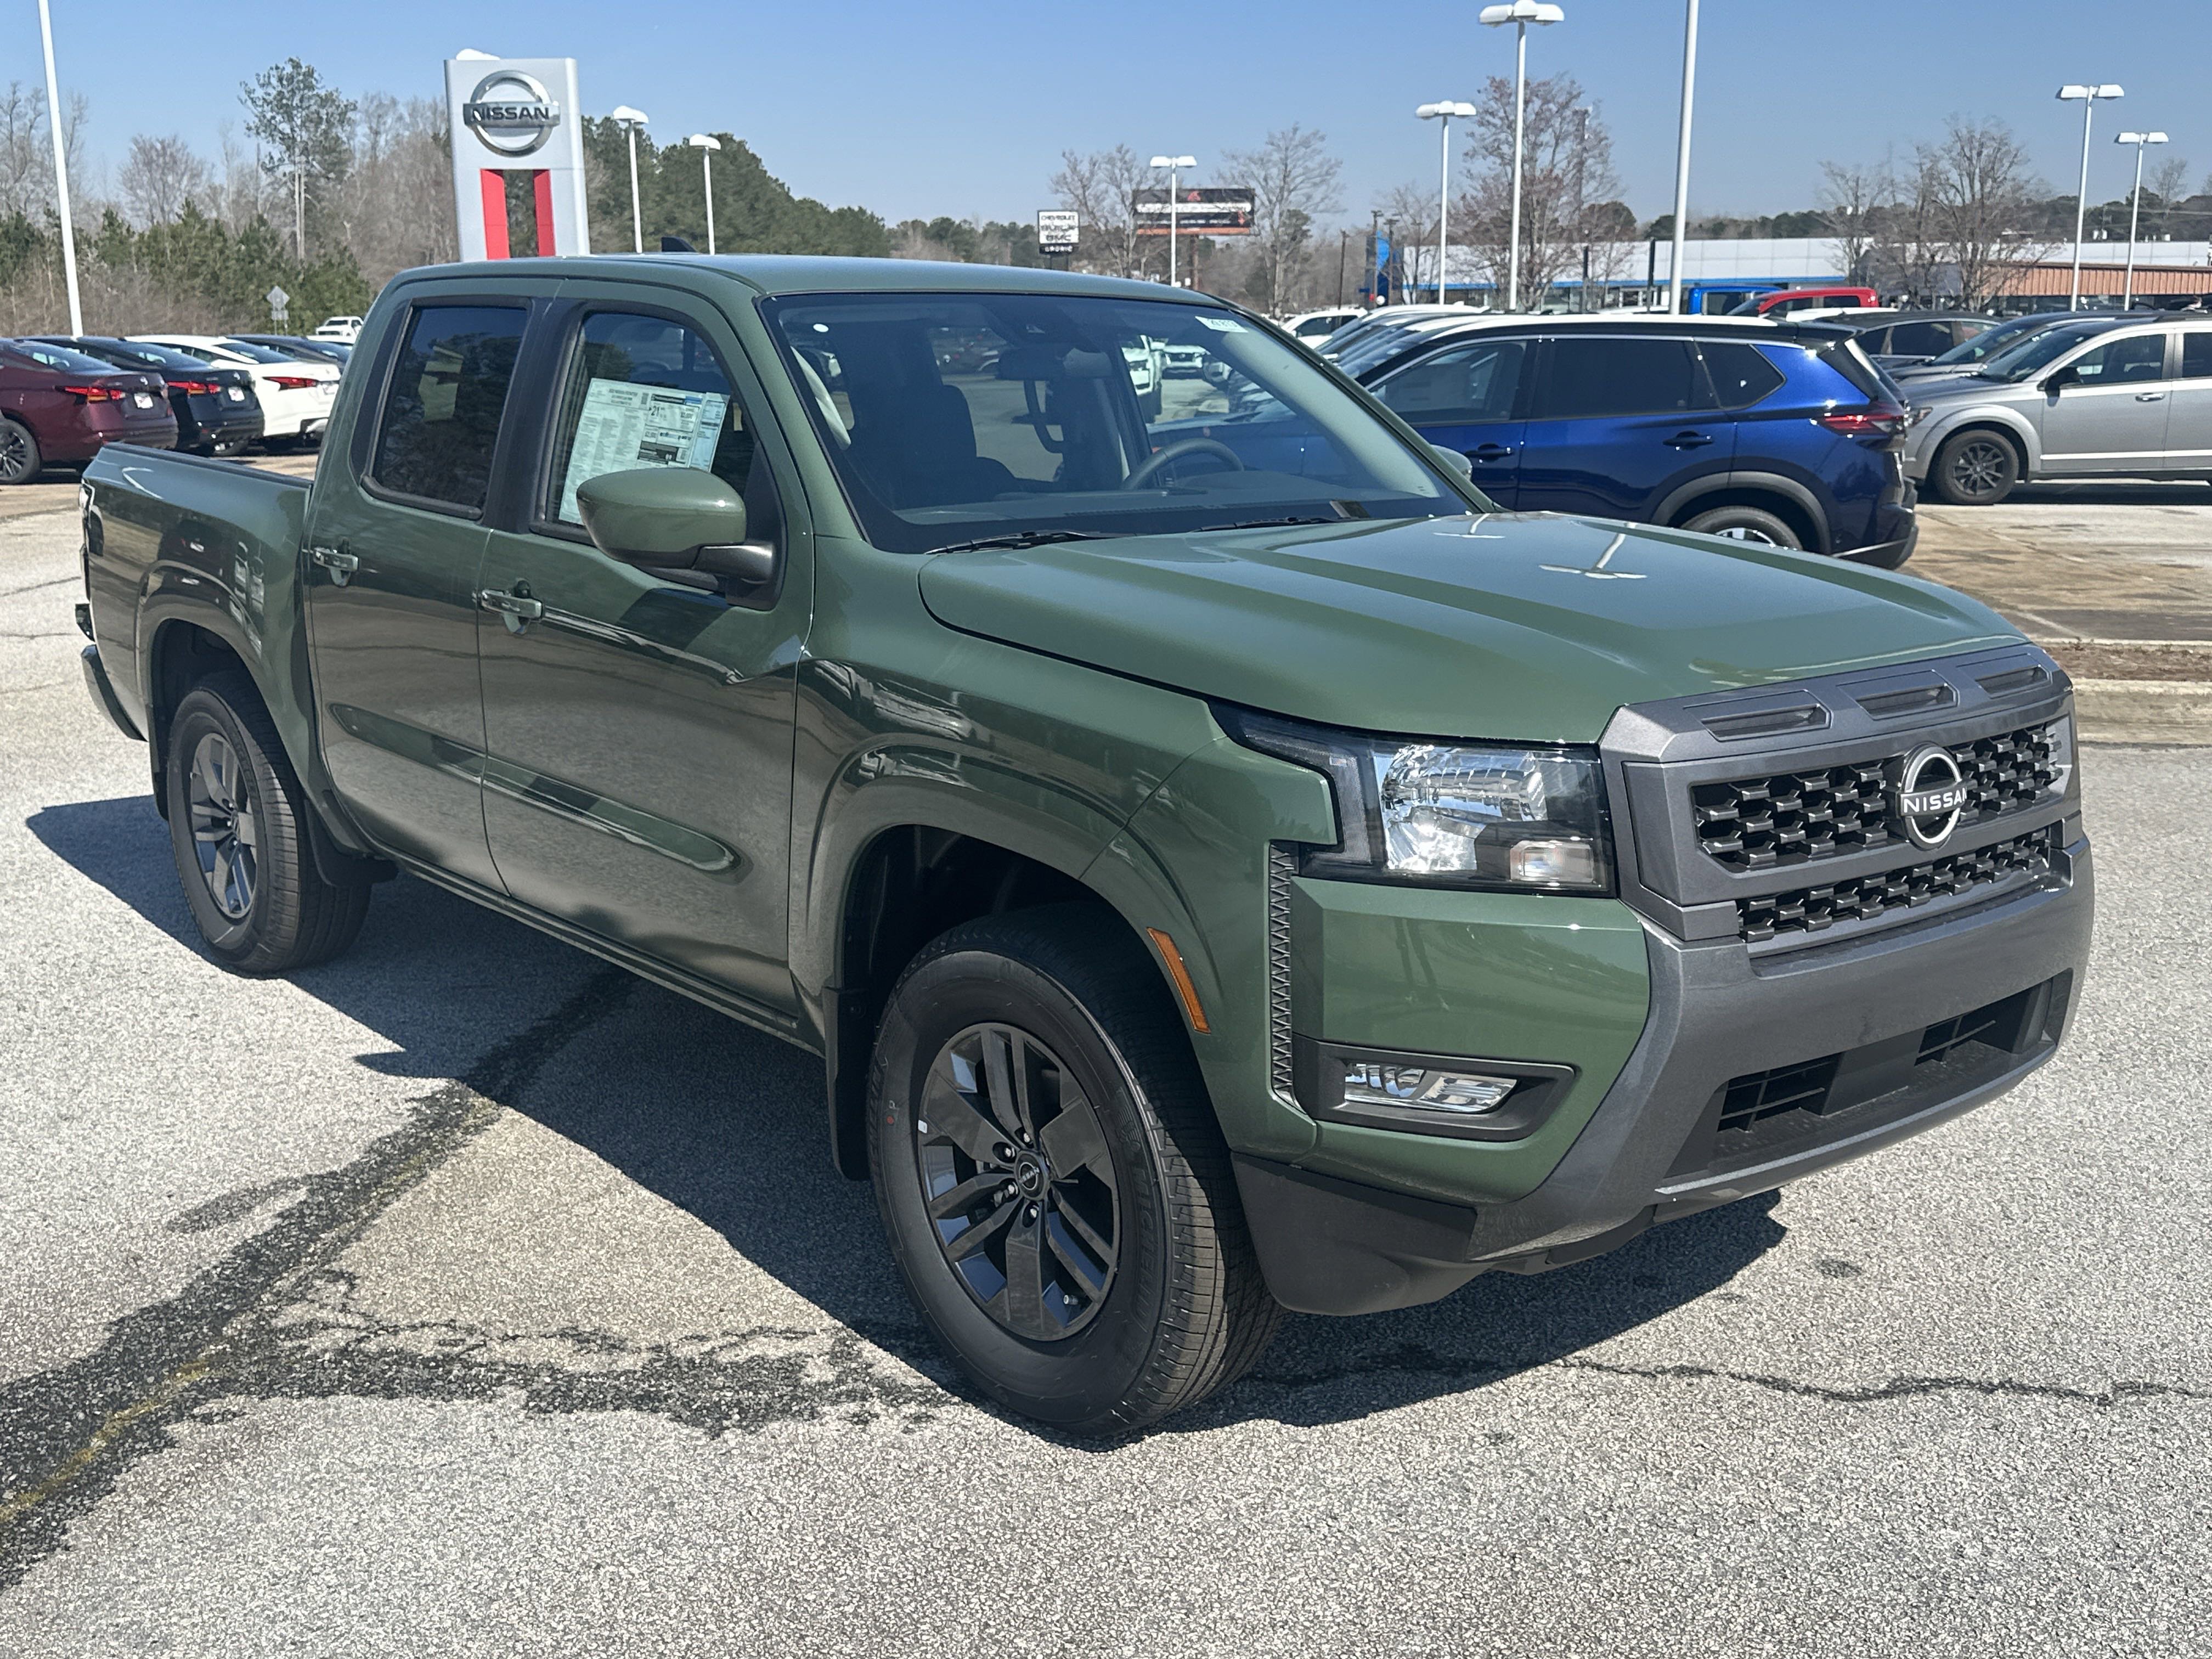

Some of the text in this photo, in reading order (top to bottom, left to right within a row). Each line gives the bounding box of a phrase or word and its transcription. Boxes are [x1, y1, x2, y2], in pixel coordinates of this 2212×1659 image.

[472, 107, 549, 120] NISSAN
[1904, 787, 1967, 813] NISSAN
[1019, 1166, 1040, 1183] NISSAN
